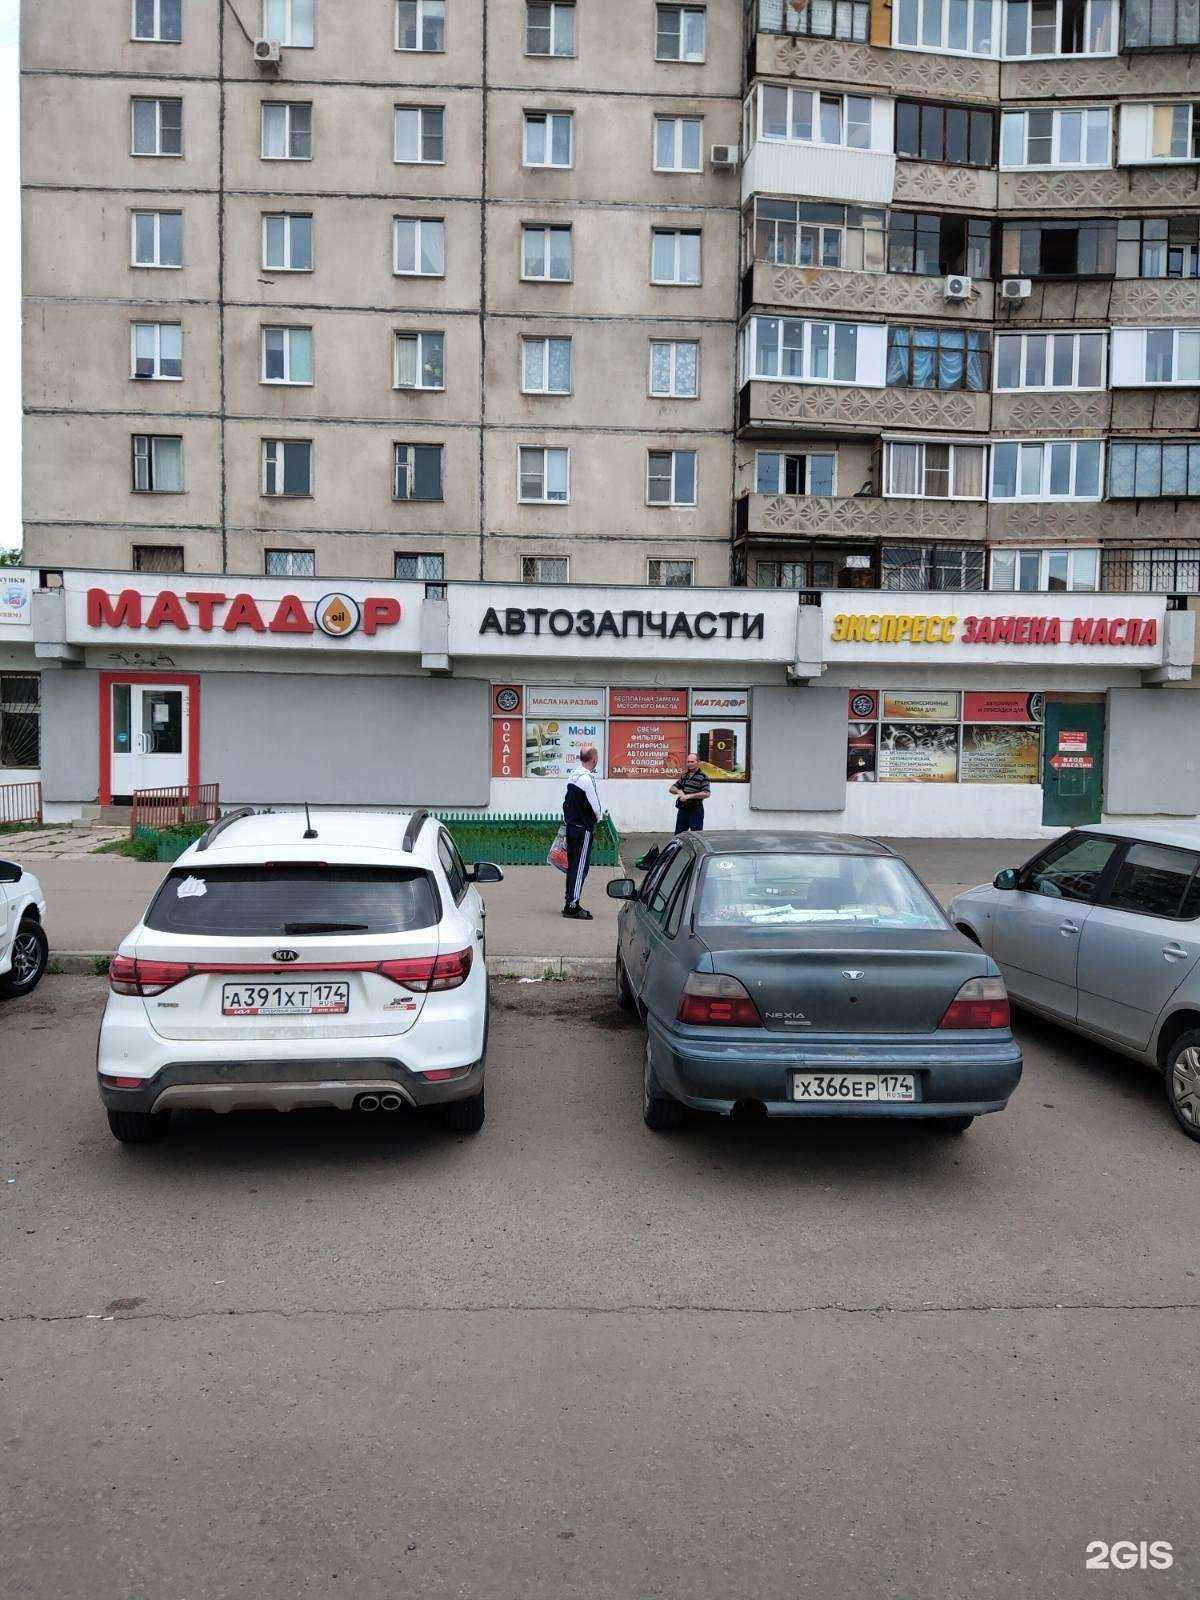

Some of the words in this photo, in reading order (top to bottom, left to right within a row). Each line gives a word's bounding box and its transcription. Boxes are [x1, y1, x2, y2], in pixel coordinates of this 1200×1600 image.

[87, 588, 400, 637] МАТАДОР
[331, 612, 346, 623] oil
[479, 607, 764, 639] АВТОЗАПЧАСТИ
[832, 613, 958, 644] ЭКСПРЕСС
[961, 615, 1060, 645] ЗАМЕНА
[1070, 617, 1157, 646] МАСЛА
[694, 699, 745, 707] МАТАДОР
[568, 726, 596, 735] Mobil
[502, 722, 511, 775] ОСАГО
[275, 952, 295, 960] KIA
[230, 987, 308, 1007] А391ХТ
[314, 986, 346, 1001] 174
[800, 1077, 876, 1097] Х366ЕР
[881, 1076, 910, 1092] 174
